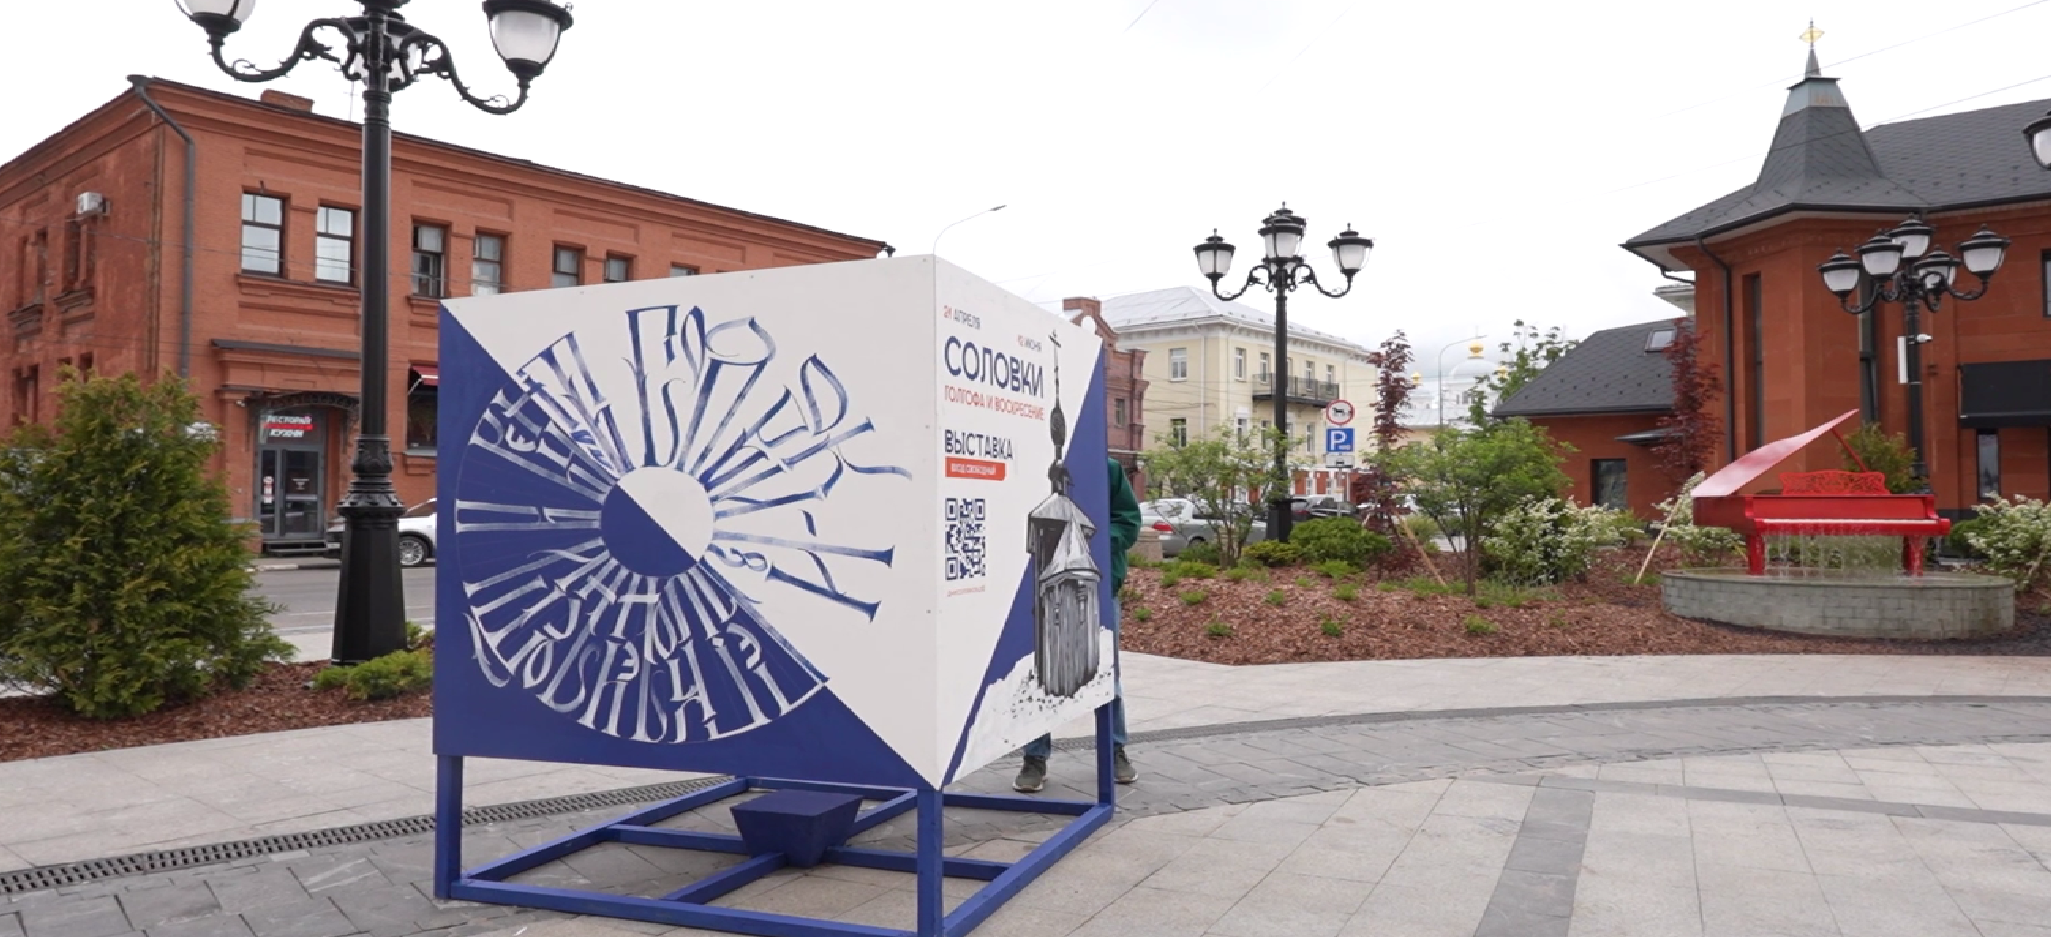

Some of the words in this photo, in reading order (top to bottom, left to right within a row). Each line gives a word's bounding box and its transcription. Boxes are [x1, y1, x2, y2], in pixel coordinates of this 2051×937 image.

[944, 335, 1044, 399] СОЛОВКИ
[944, 385, 985, 409] ГОЛГОФА
[986, 395, 993, 410] И
[994, 396, 1045, 421] ВОСКРЕСЕНИЕ
[944, 429, 1014, 461] ВЫСТАВКА
[1331, 431, 1346, 451] P
